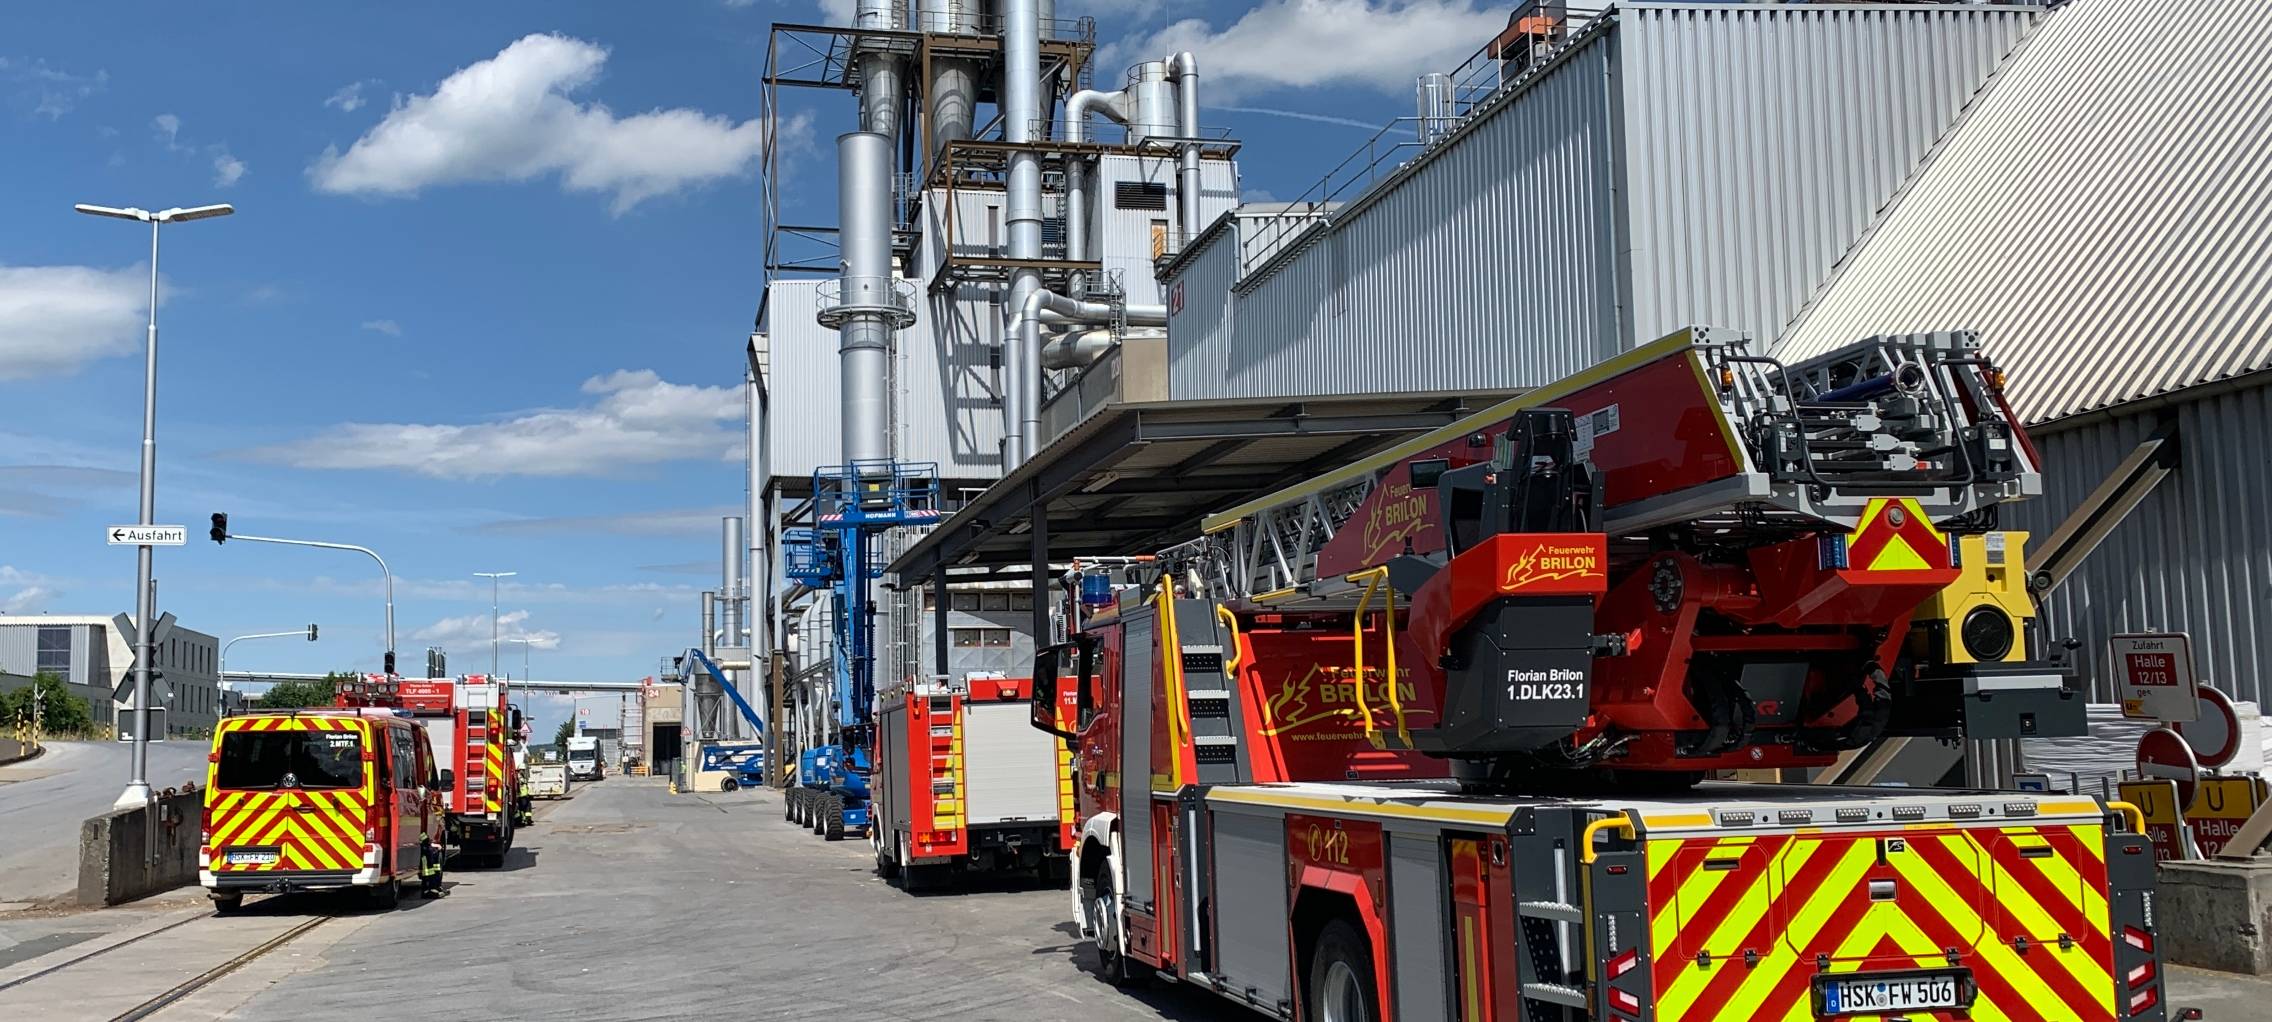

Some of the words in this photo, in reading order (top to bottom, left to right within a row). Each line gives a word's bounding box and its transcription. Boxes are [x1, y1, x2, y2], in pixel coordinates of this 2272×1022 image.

[1172, 283, 1184, 313] 21
[1386, 494, 1427, 526] BRILON
[128, 530, 182, 541] Ausfahrt
[1548, 546, 1595, 555] Feuerwehr
[1540, 556, 1595, 570] BRILON
[2132, 641, 2165, 650] Zufahrt
[2134, 655, 2166, 668] Halle
[1507, 670, 1547, 682] Florian
[1549, 669, 1583, 681] Brilon
[2137, 671, 2167, 684] 12/13
[648, 689, 660, 698] 24
[1320, 683, 1416, 703] BRLON
[1507, 683, 1584, 700] 1.DLK23.1
[2139, 791, 2154, 818] U
[2205, 786, 2224, 812] U
[2147, 825, 2168, 843] alle
[2199, 819, 2240, 836] Halle
[1324, 829, 1349, 865] 112
[1840, 984, 1876, 1009] HSK
[1889, 983, 1912, 1006] FW
[1917, 980, 1952, 1004] 506
